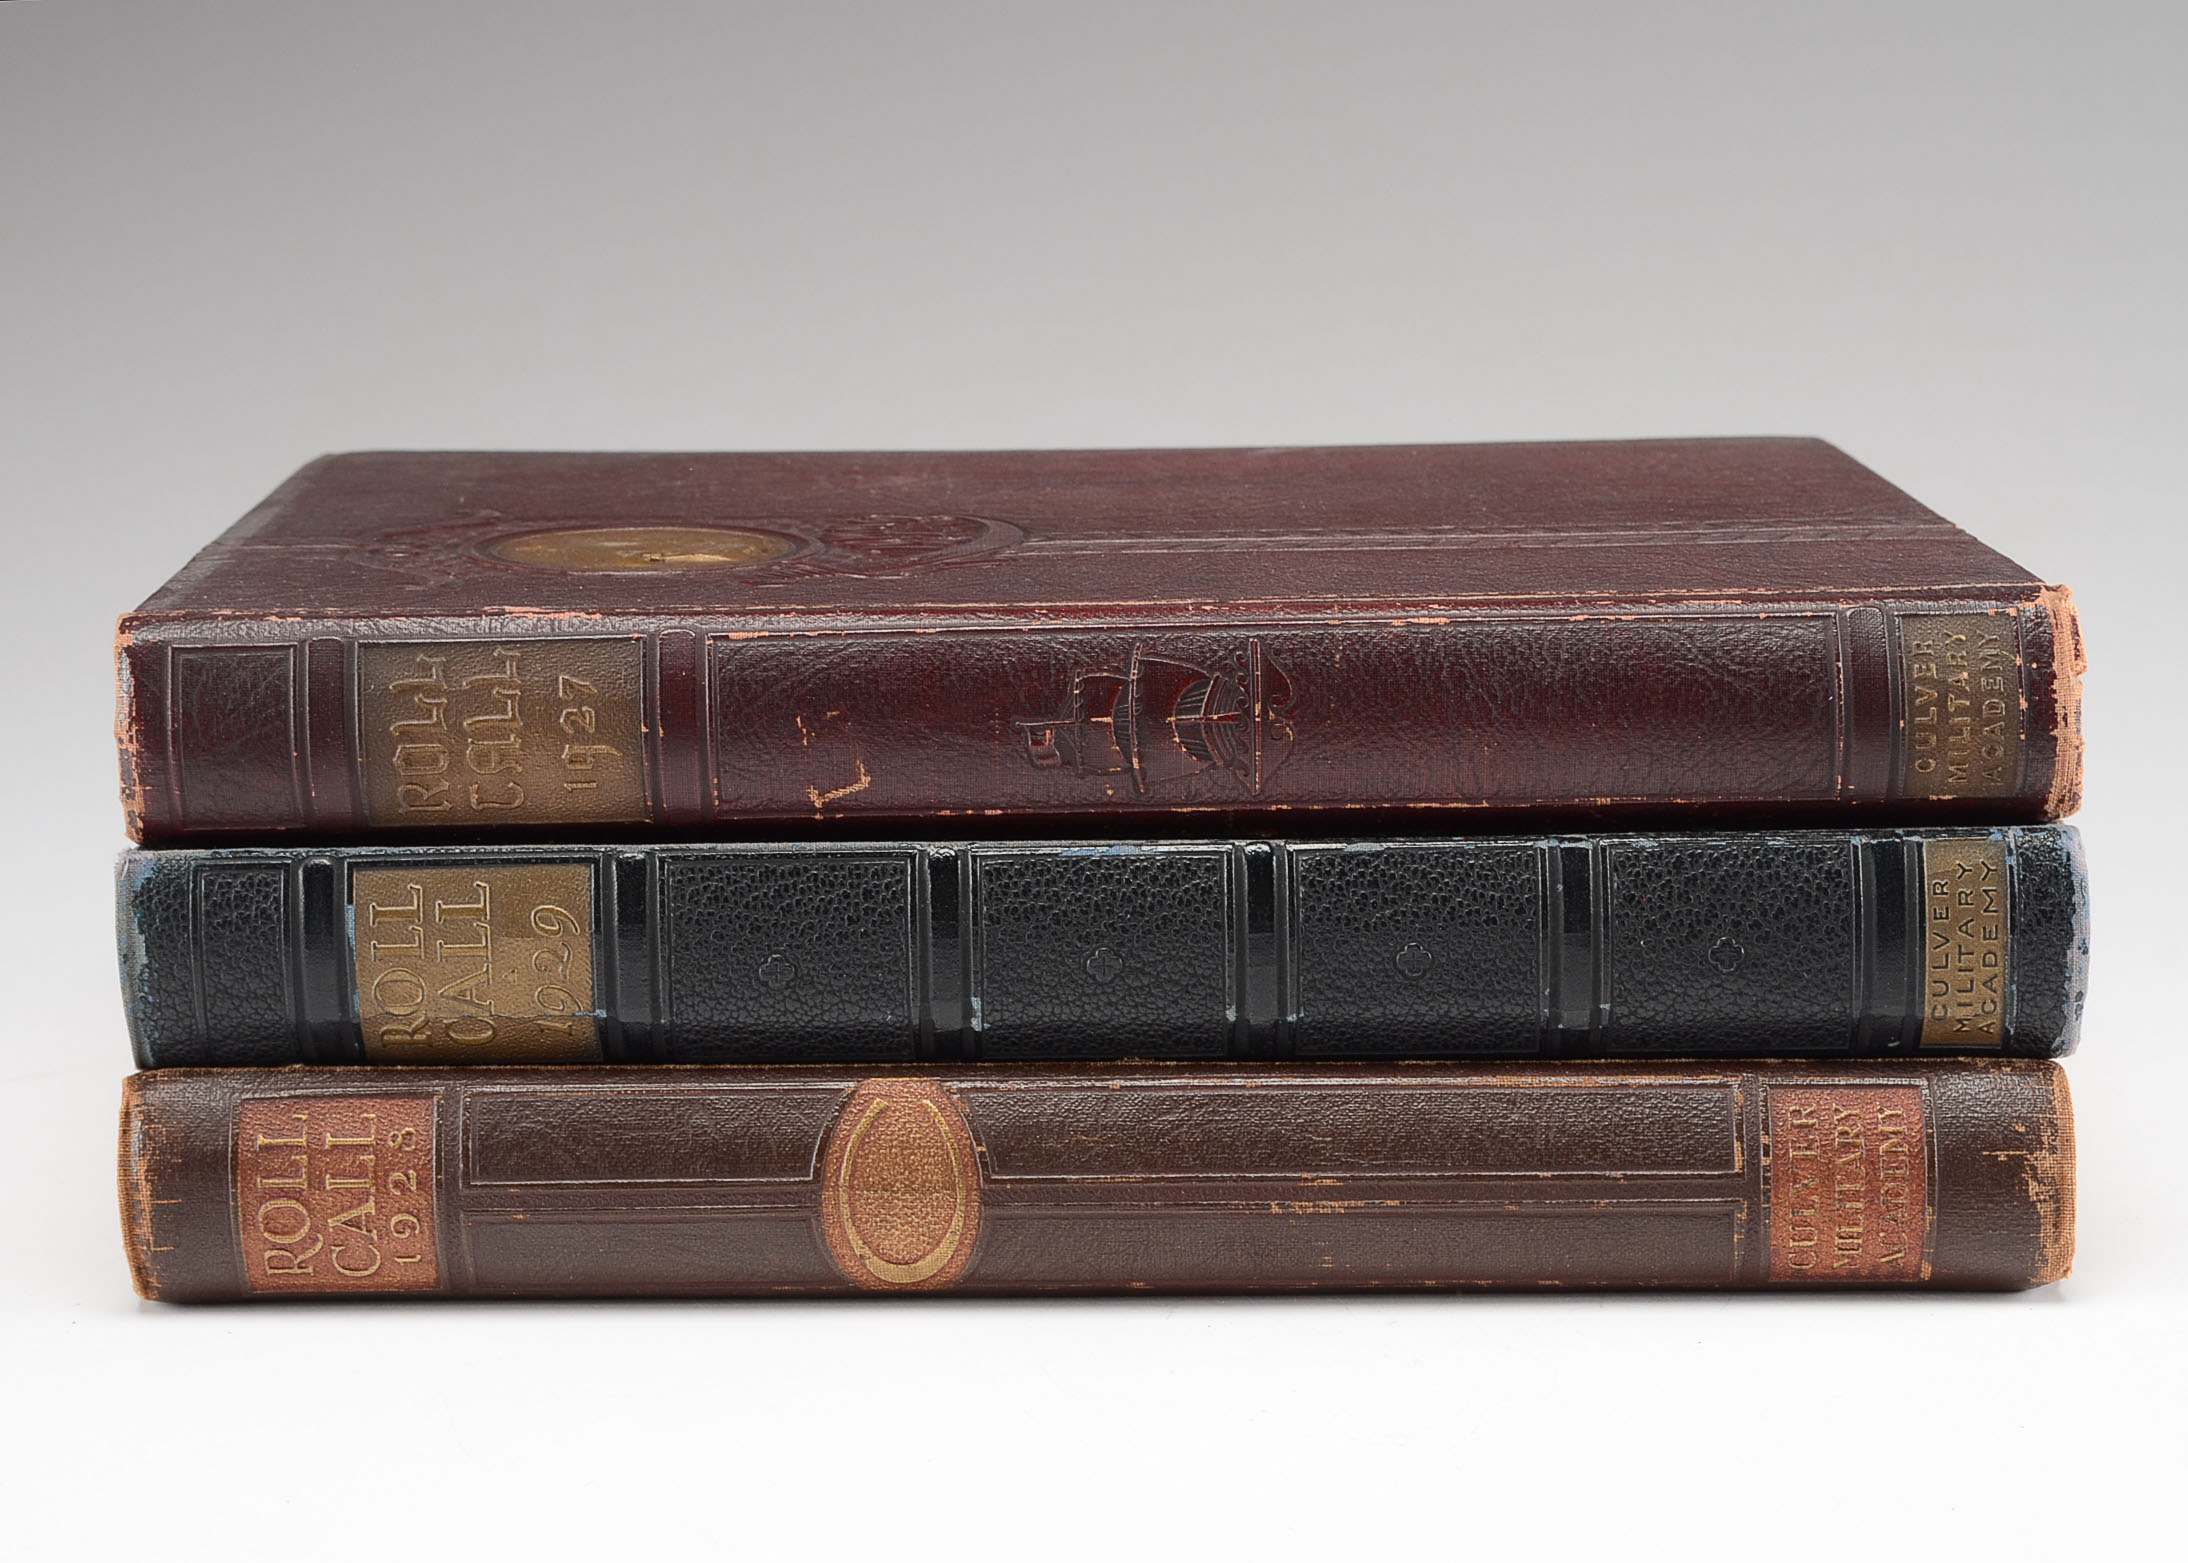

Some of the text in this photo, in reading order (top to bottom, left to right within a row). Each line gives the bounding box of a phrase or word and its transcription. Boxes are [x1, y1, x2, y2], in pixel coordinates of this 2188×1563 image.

[389, 653, 453, 815] ROLL
[558, 675, 623, 793] 1927
[1912, 640, 1939, 773] CULVER
[1944, 629, 1971, 783] MILITARY
[1975, 630, 2006, 785] ACADEMY
[370, 883, 433, 1049] ROLL
[435, 881, 497, 1046] CALL
[531, 904, 581, 1036] 1929
[1931, 880, 1950, 1021] CULVER
[1953, 861, 1975, 1033] MILITARY
[1978, 860, 1999, 1034] ACADEMY
[257, 1113, 324, 1276] ROLL
[325, 1113, 382, 1277] CALL
[387, 1127, 422, 1266] 1928
[1788, 1103, 1823, 1270] CULVER
[1833, 1103, 1865, 1269] MILITARY
[1877, 1103, 1909, 1267] ACADEMY
